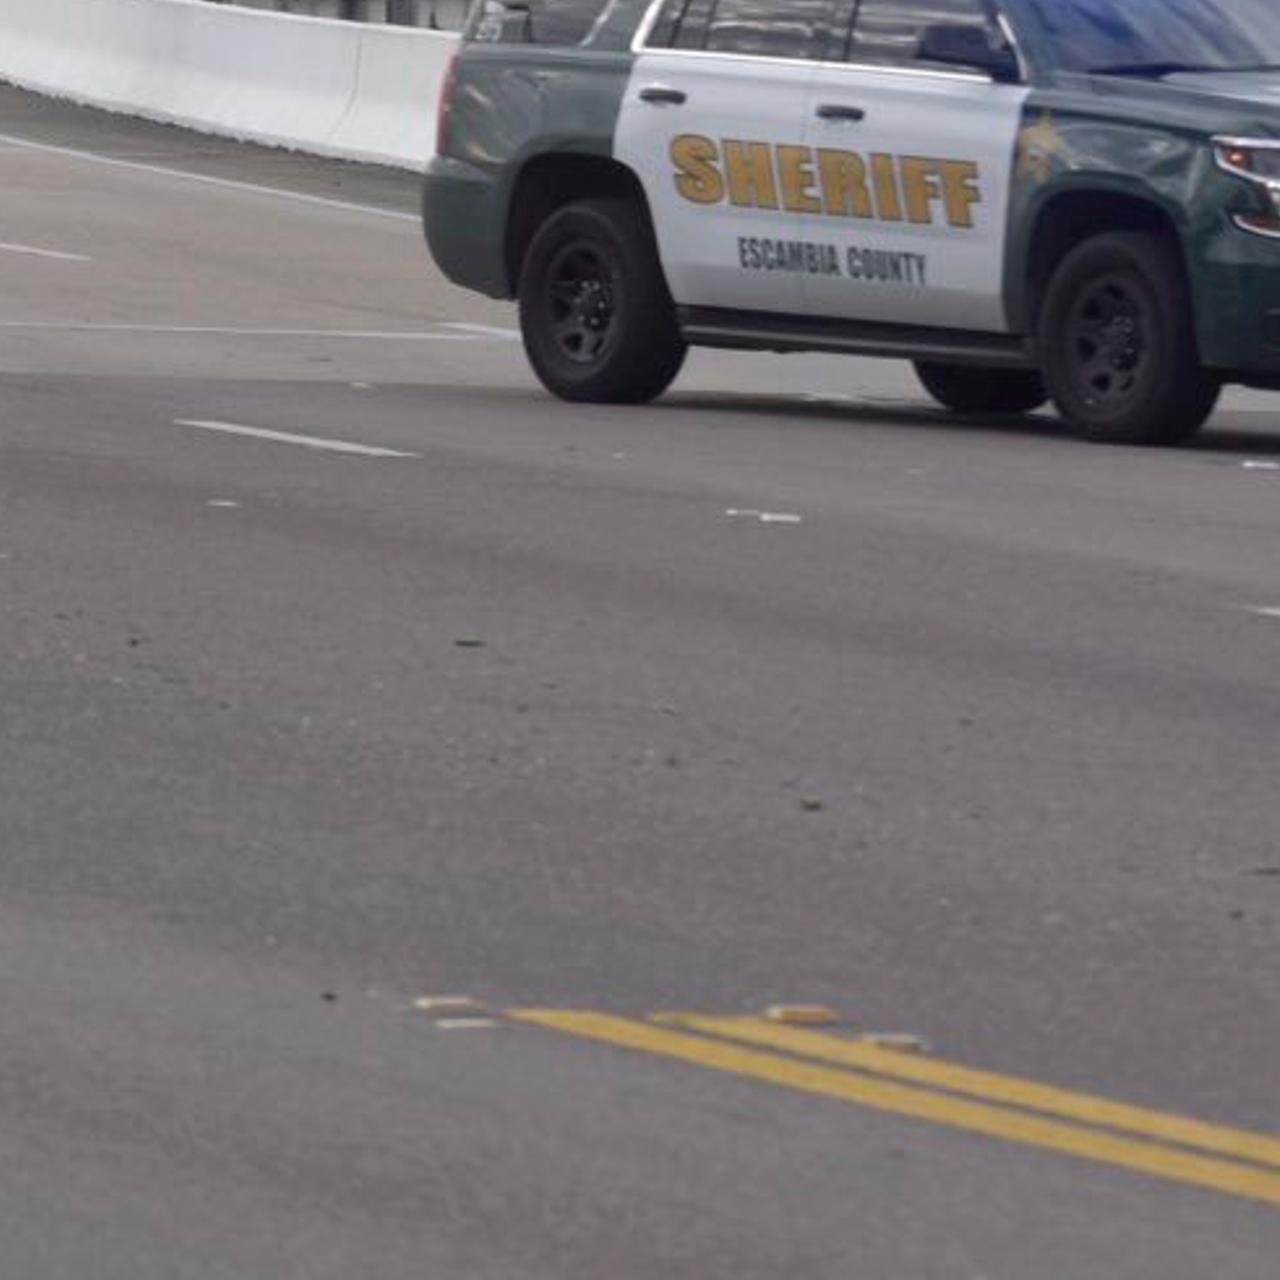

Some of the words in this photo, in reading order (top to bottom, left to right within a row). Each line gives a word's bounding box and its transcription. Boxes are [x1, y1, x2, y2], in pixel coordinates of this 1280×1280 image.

[669, 134, 983, 229] SHERIFF
[738, 237, 842, 277] ESCAMBIA
[846, 246, 926, 286] COUNTY
